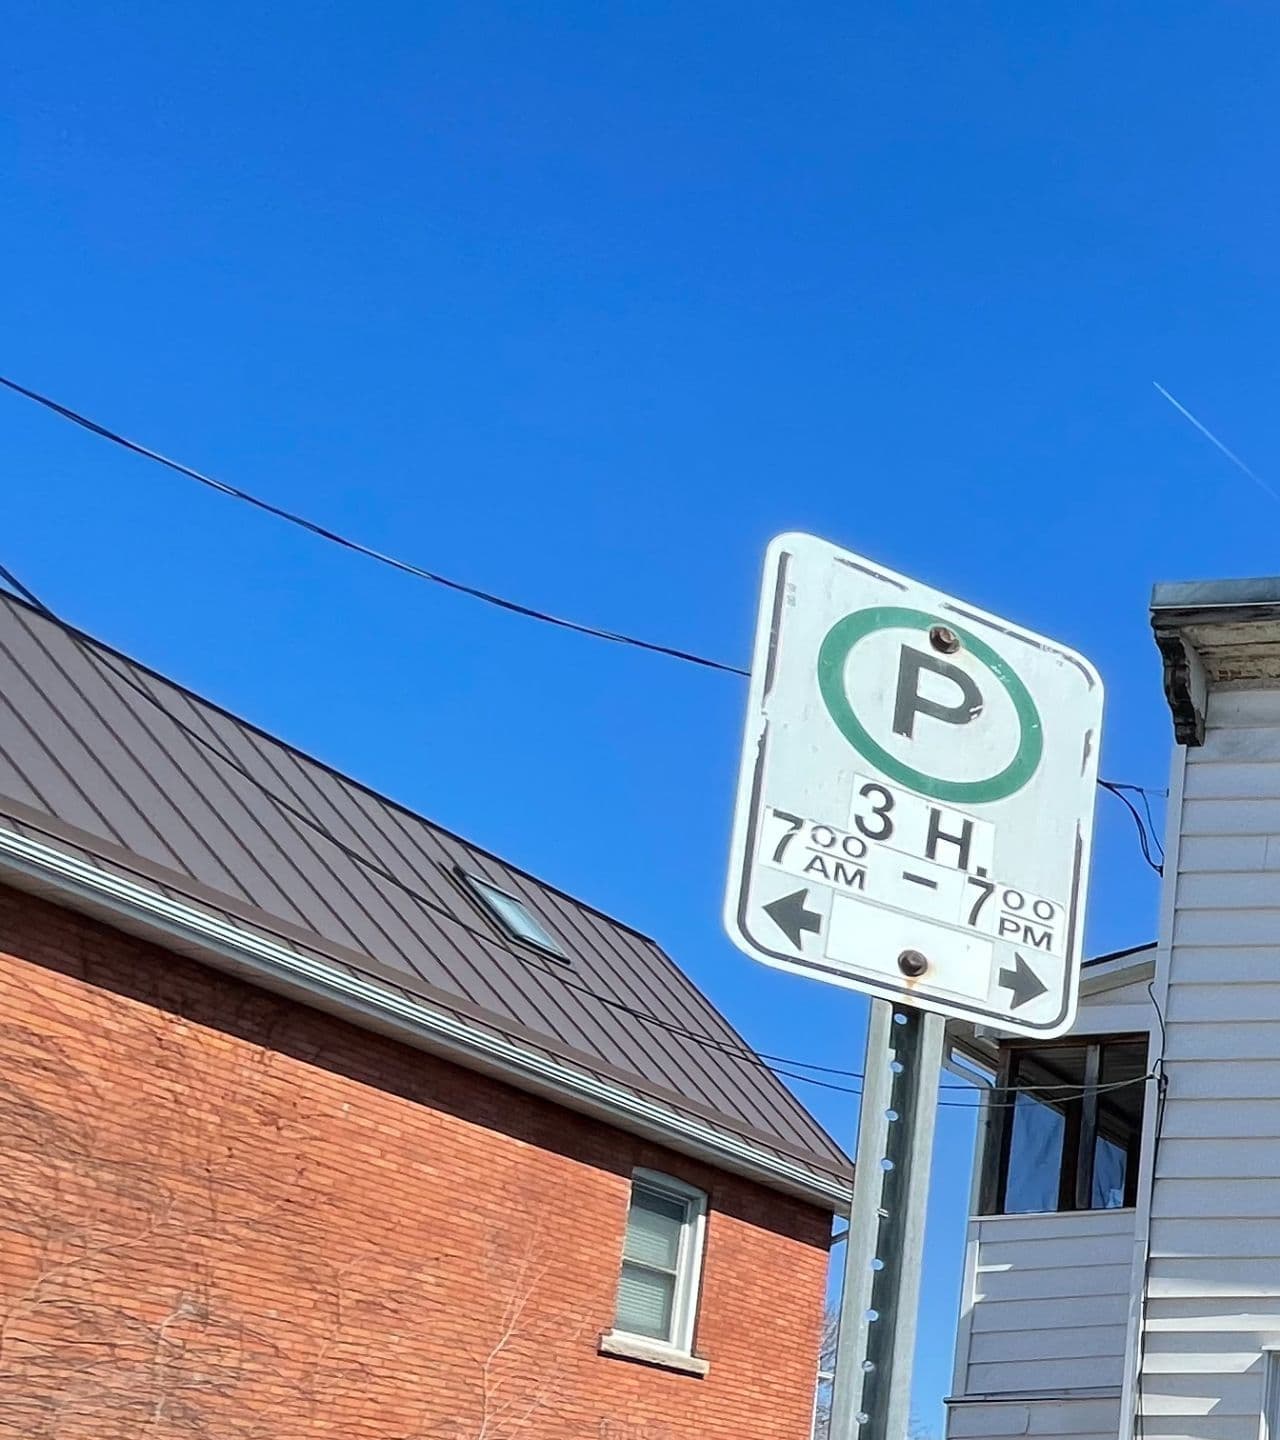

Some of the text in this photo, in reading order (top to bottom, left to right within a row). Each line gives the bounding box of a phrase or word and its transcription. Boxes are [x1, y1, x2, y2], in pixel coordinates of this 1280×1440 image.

[892, 644, 984, 739] P
[854, 783, 895, 841] 3
[803, 855, 866, 890] AM
[998, 917, 1053, 951] PM
